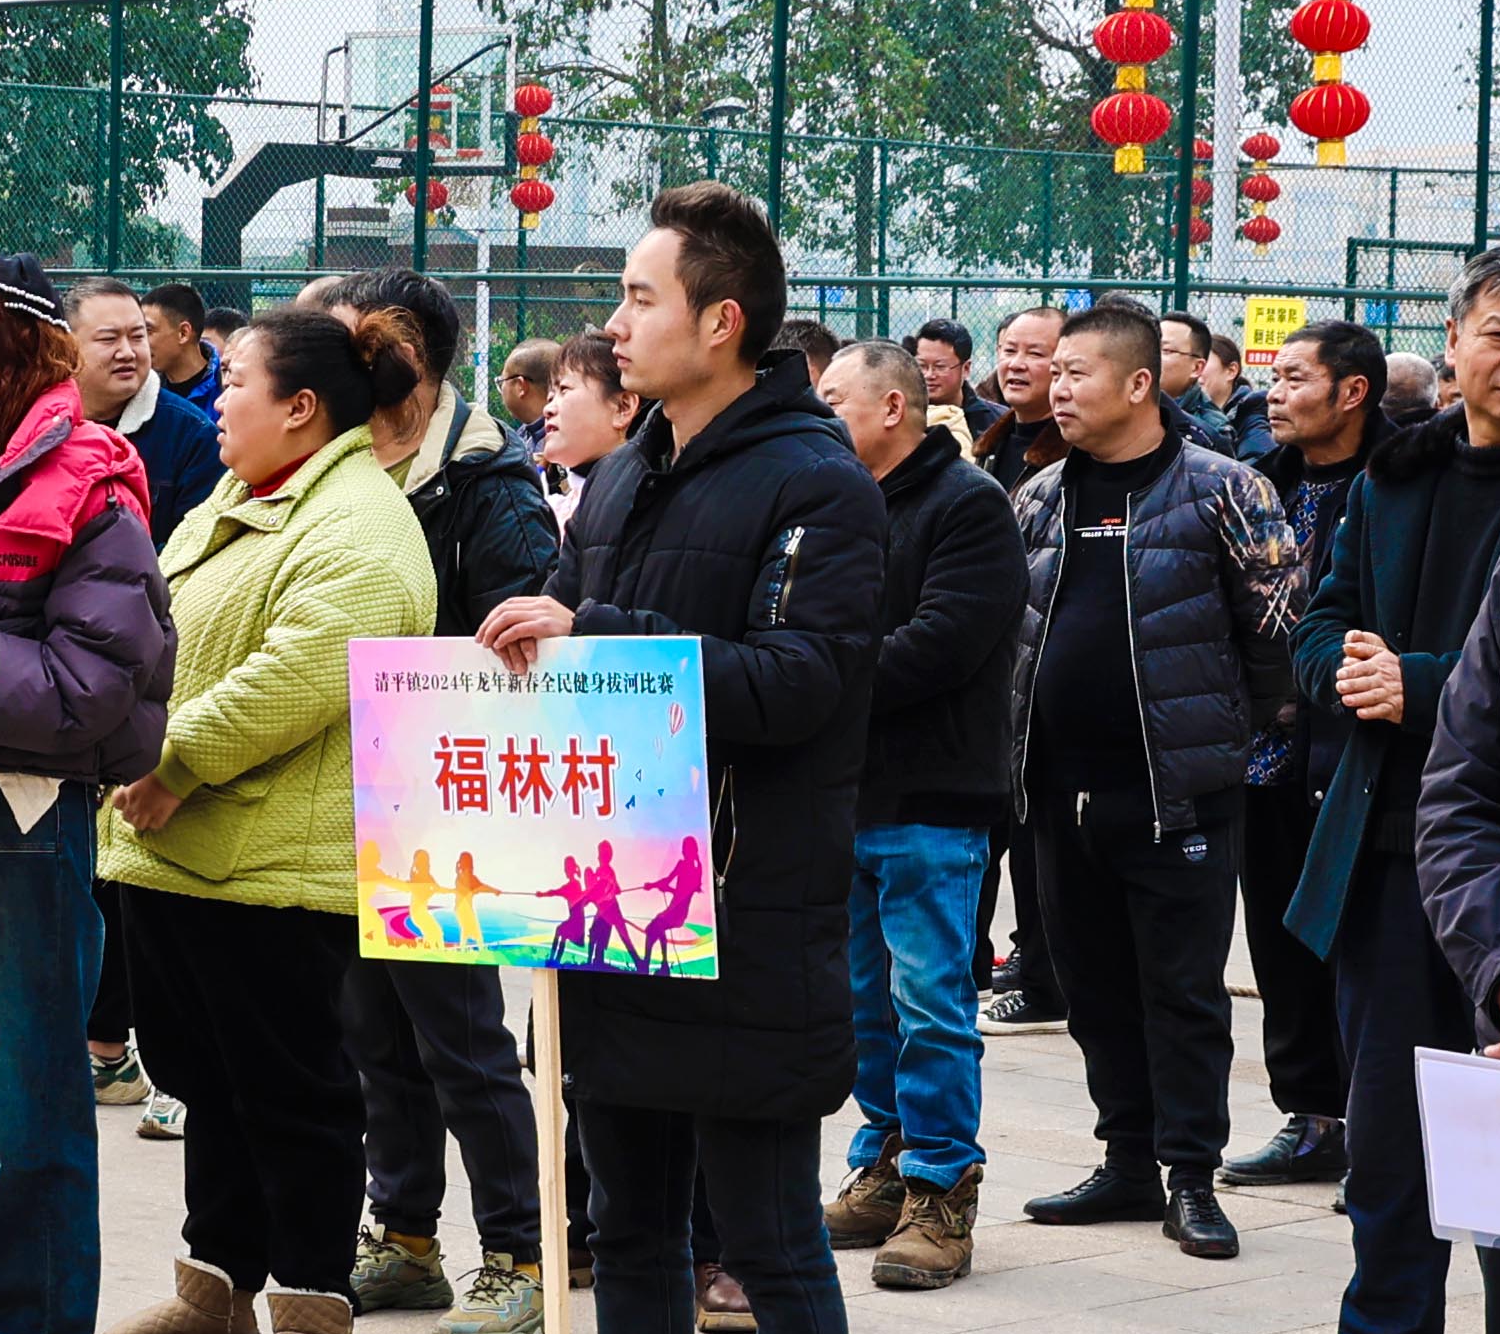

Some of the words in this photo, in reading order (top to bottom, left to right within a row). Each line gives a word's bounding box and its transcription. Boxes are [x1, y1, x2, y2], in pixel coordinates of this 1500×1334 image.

[1253, 328, 1288, 345] 翻越护
[374, 670, 675, 696] 清平镇2024年龙年新春全民健身拔河比赛
[433, 734, 617, 817] 福林村
